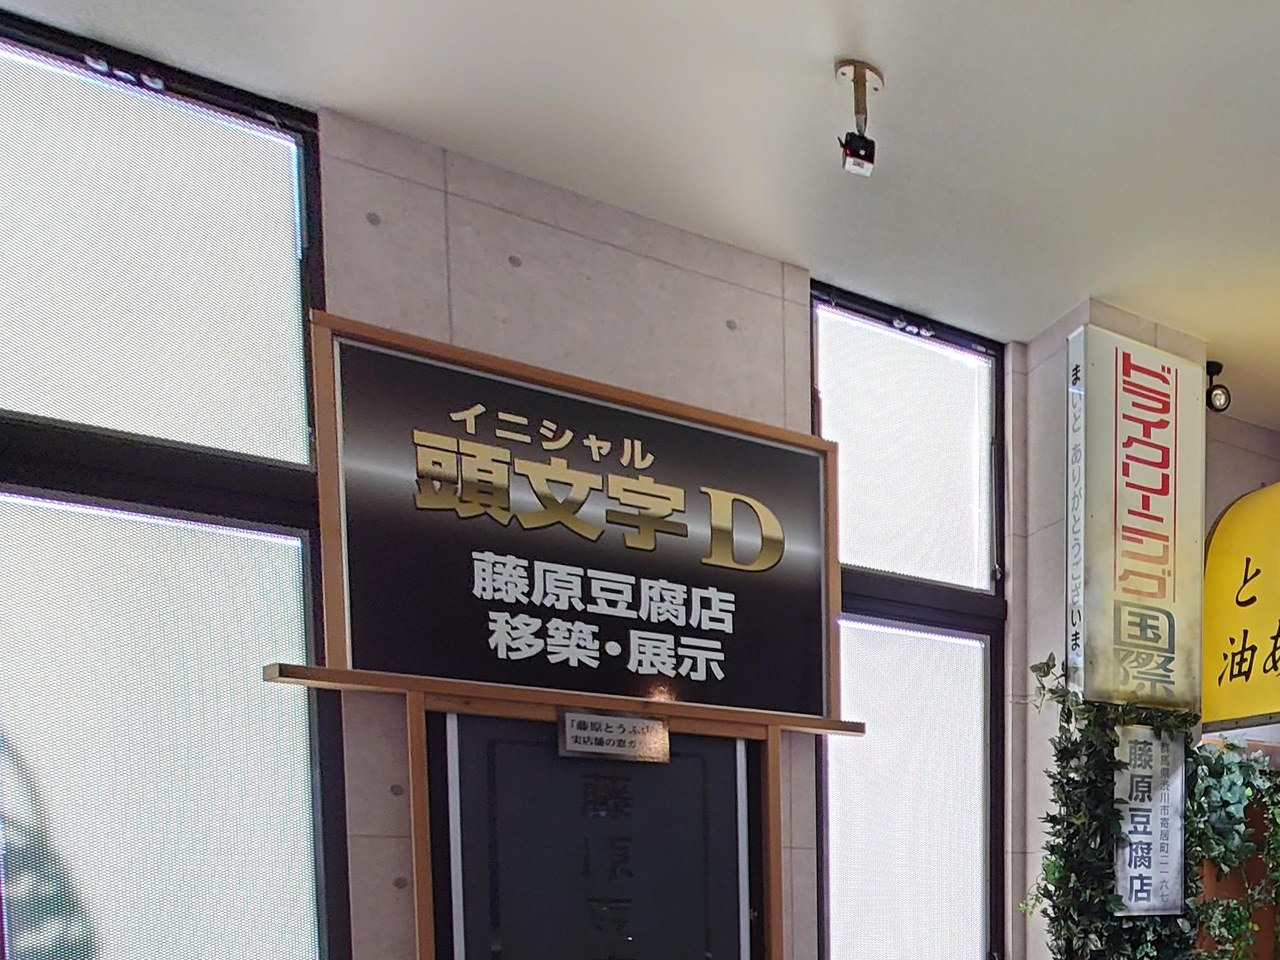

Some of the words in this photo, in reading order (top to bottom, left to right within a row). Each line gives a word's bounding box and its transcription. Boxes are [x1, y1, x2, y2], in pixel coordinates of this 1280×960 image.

[449, 402, 655, 471] イニシャル
[471, 550, 736, 634] 藤原豆腐店
[489, 611, 726, 682] 移築・展示
[1112, 598, 1176, 698] 国際
[1127, 740, 1153, 904] 藤原豆腐店
